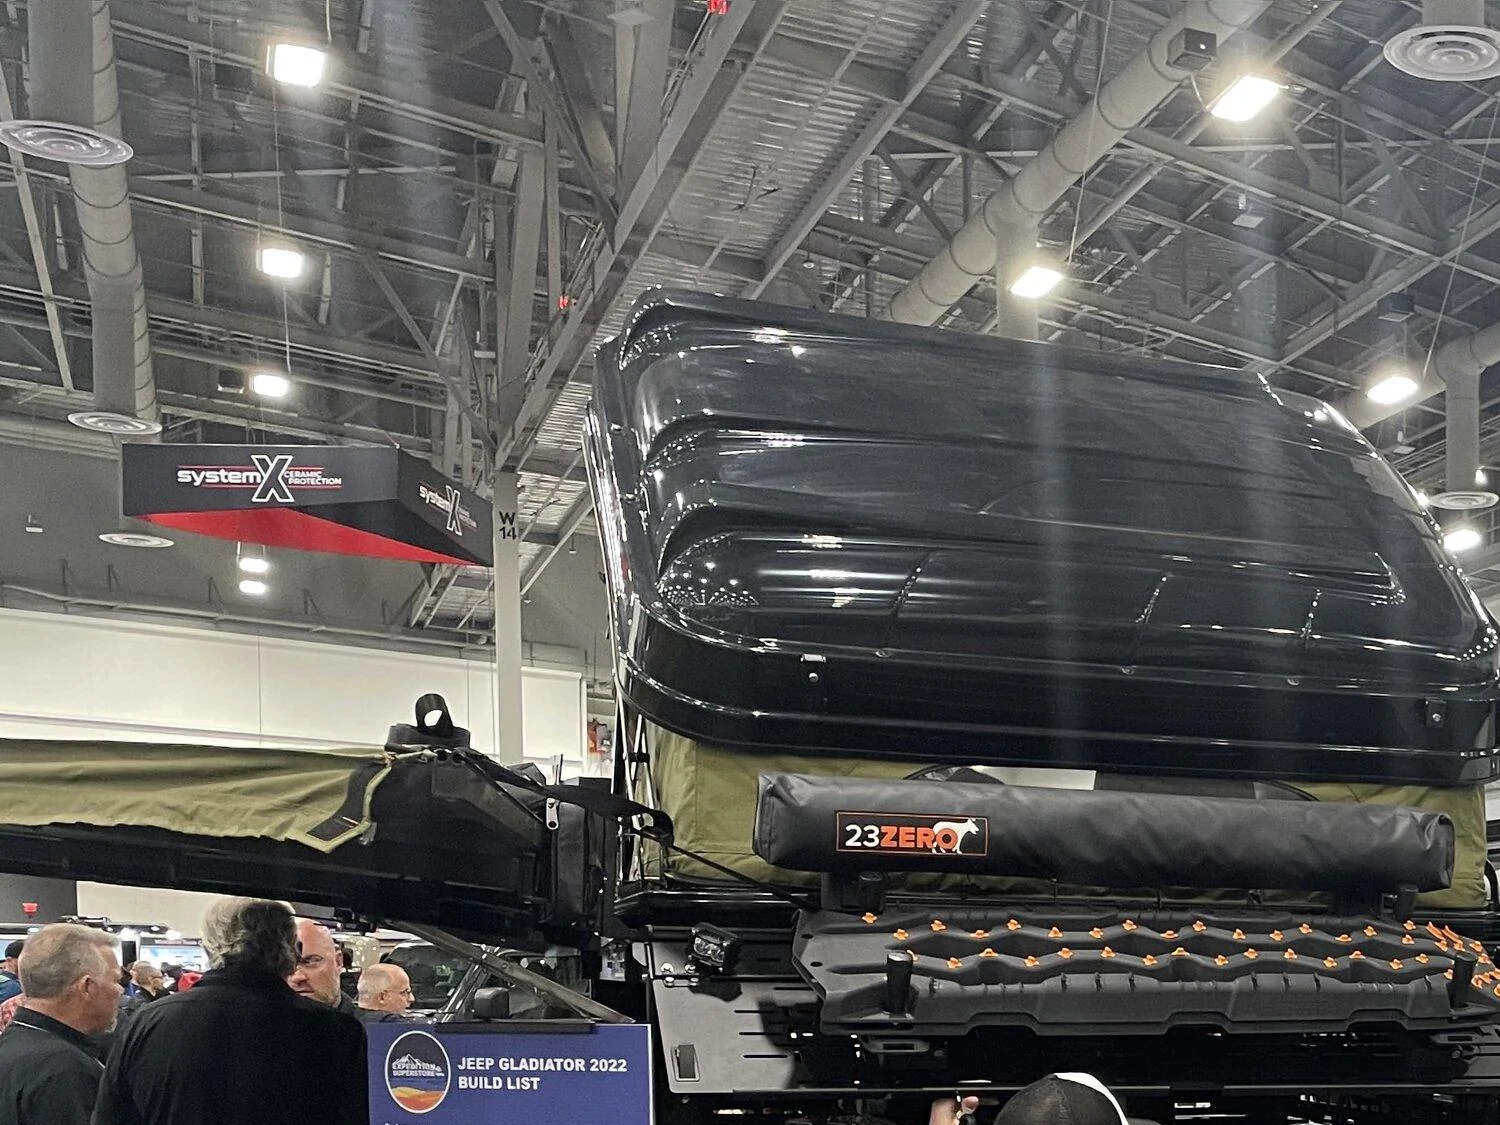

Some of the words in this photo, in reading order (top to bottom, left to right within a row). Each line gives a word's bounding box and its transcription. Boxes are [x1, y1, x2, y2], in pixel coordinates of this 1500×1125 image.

[499, 511, 516, 525] W
[499, 526, 517, 540] 14
[845, 824, 958, 849] 23ZERO
[458, 1057, 494, 1070] JEEP
[498, 1058, 585, 1072] GLADIATOR
[589, 1058, 628, 1072] 2022
[458, 1076, 502, 1089] BUILD
[507, 1077, 540, 1090] LIST
